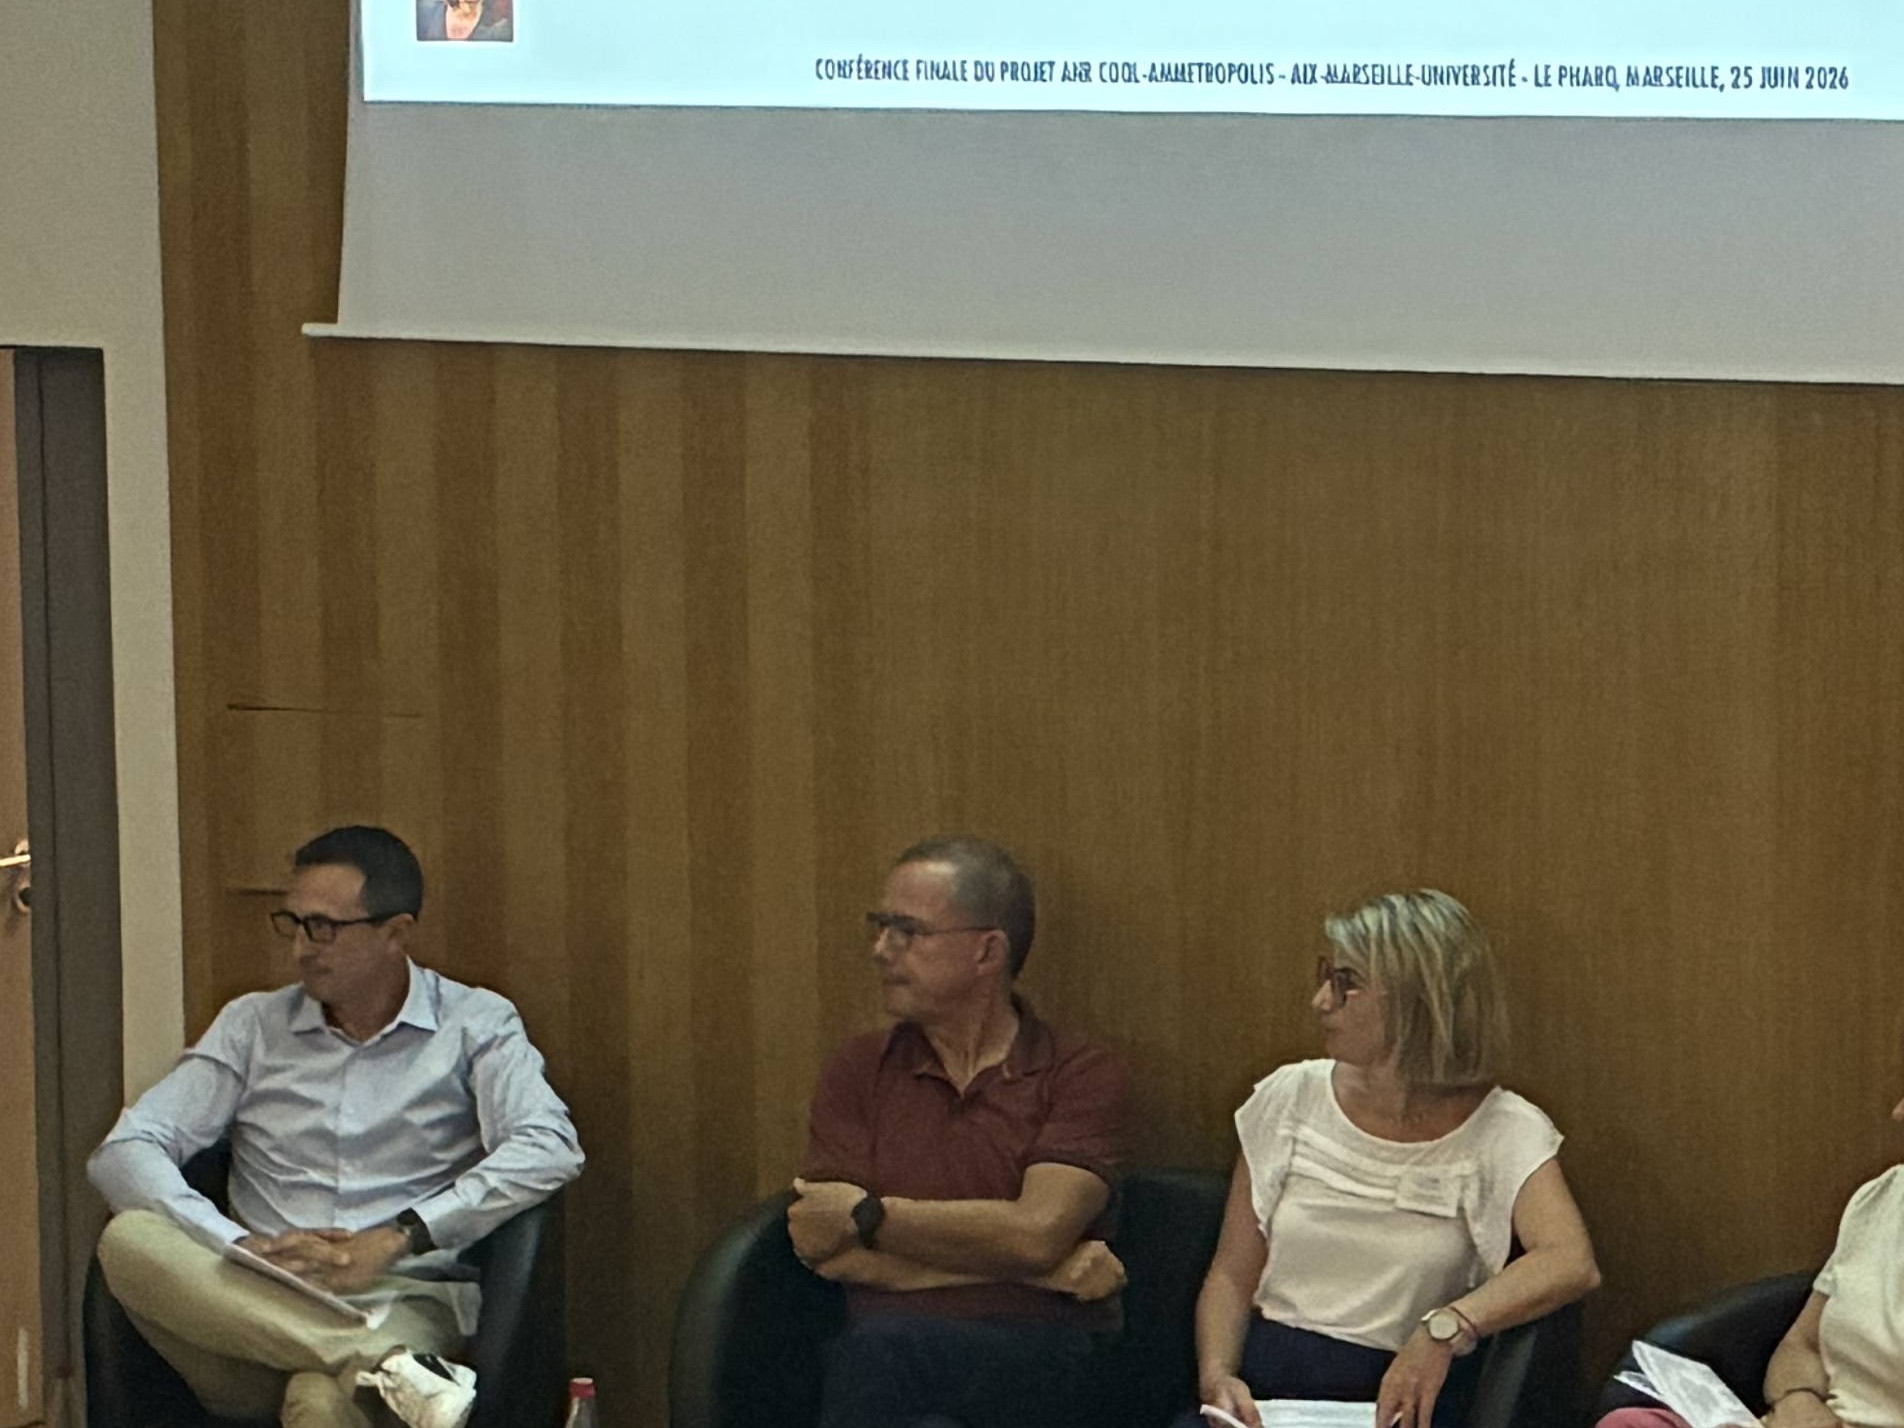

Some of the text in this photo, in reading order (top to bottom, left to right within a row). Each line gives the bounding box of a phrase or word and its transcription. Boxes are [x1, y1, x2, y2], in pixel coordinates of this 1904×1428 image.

[915, 59, 968, 83] FINALE
[973, 59, 995, 83] DU
[999, 60, 1056, 83] PROJET
[1534, 63, 1553, 88] LE
[1625, 65, 1726, 93] MARSEILLE,
[1730, 65, 1753, 90] 25
[1759, 65, 1800, 90] JUIN
[1804, 65, 1849, 90] 2026
